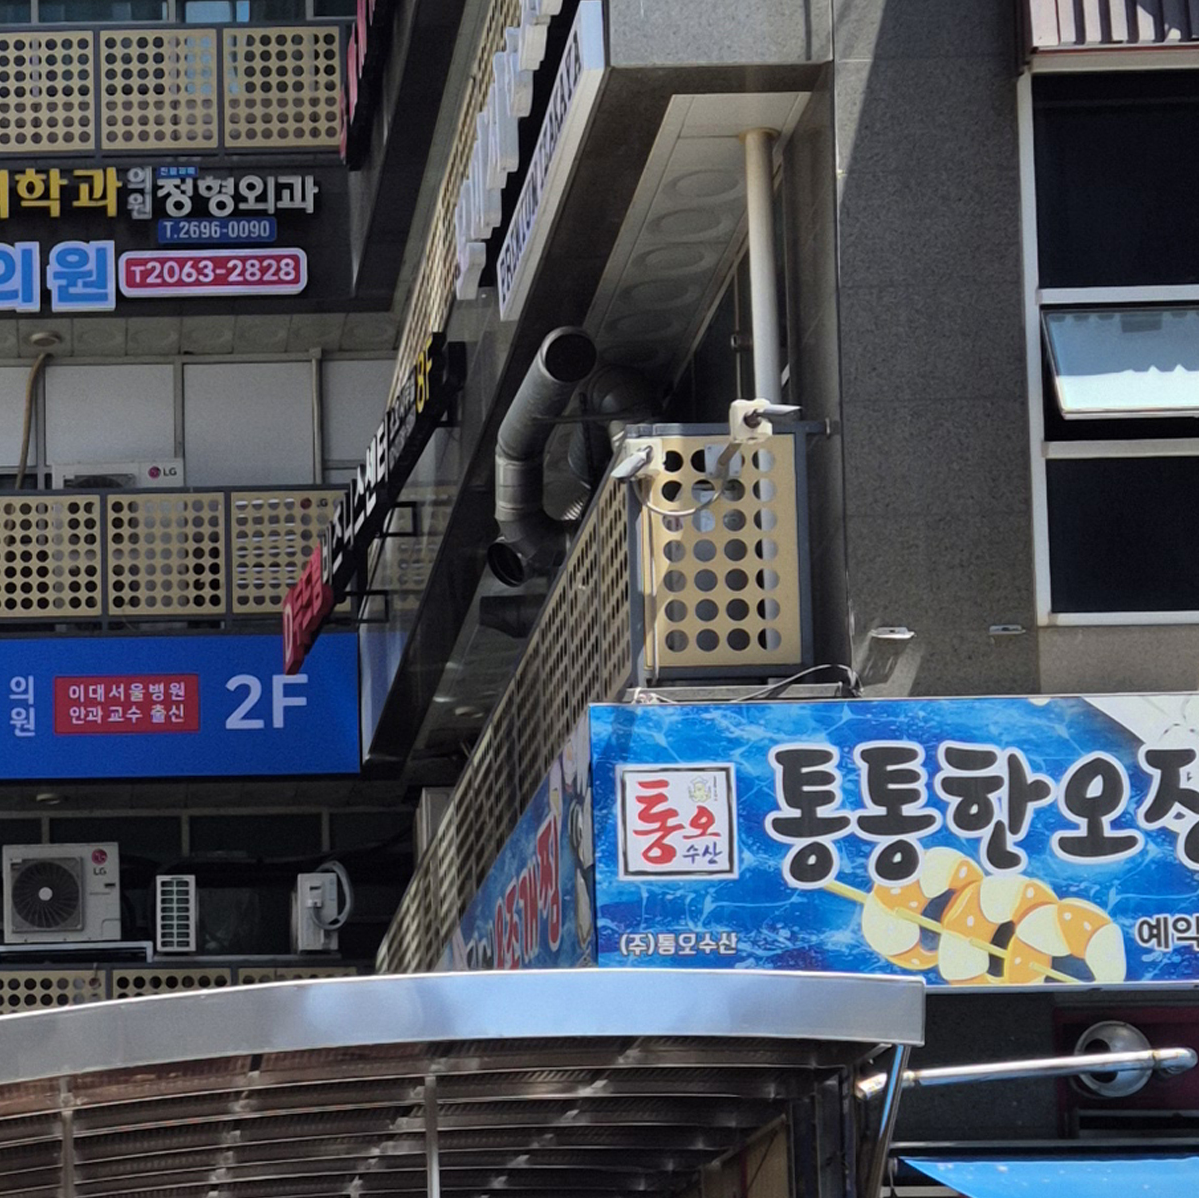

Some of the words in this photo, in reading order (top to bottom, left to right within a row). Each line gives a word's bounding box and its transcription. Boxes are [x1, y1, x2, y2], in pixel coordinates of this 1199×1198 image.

[157, 175, 319, 217] 정형외과
[164, 221, 270, 239] T.2696-0090
[130, 258, 297, 287] T2063-2828
[163, 467, 177, 476] LG
[69, 682, 186, 702] 이대서울병원
[226, 673, 309, 730] 2F
[69, 705, 103, 725] 안과
[106, 704, 142, 724] 교수
[150, 703, 186, 724] 출신
[93, 867, 106, 876] LG
[620, 932, 738, 956] (주)통오수산
